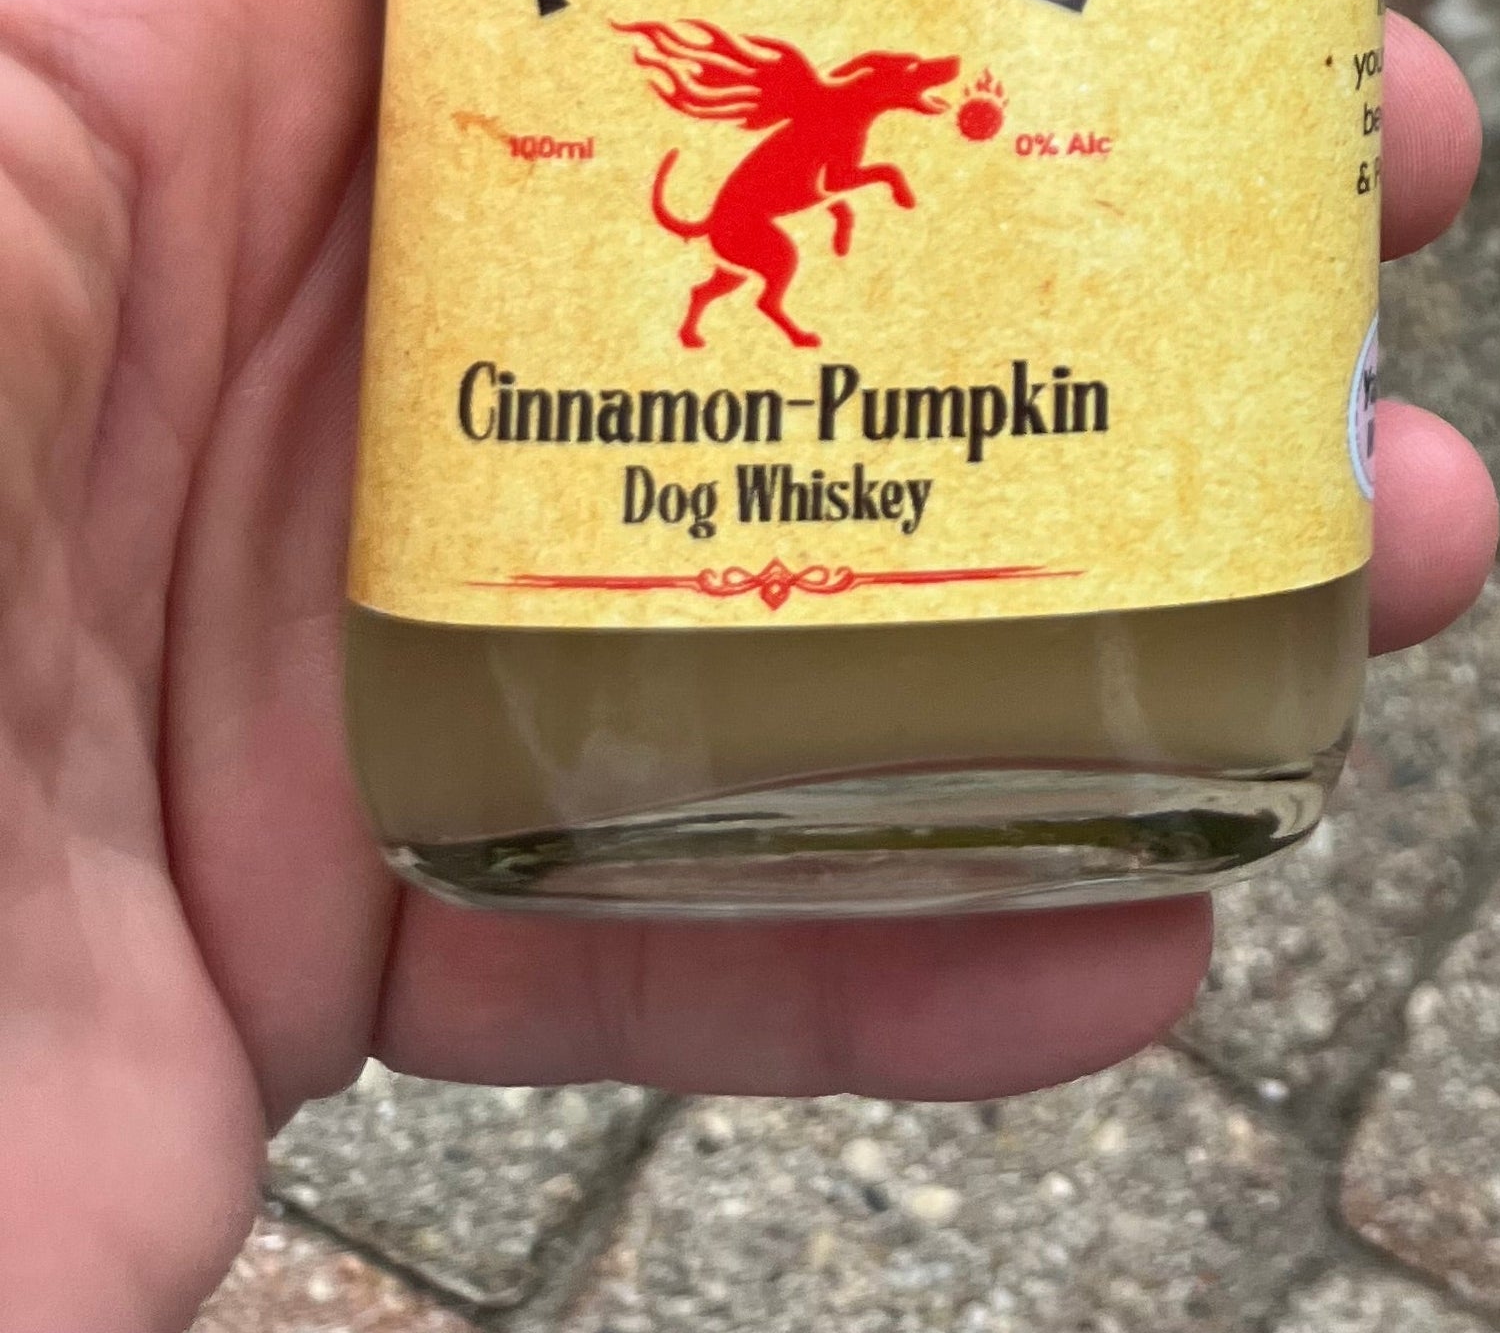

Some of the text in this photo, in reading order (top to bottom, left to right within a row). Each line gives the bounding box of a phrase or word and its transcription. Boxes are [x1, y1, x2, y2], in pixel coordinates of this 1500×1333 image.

[508, 134, 595, 162] 100ml
[1015, 132, 1113, 157] 0% Alc
[457, 358, 1110, 464] Cinnamon-Pumpkin
[622, 462, 933, 540] Dog Whiskey
